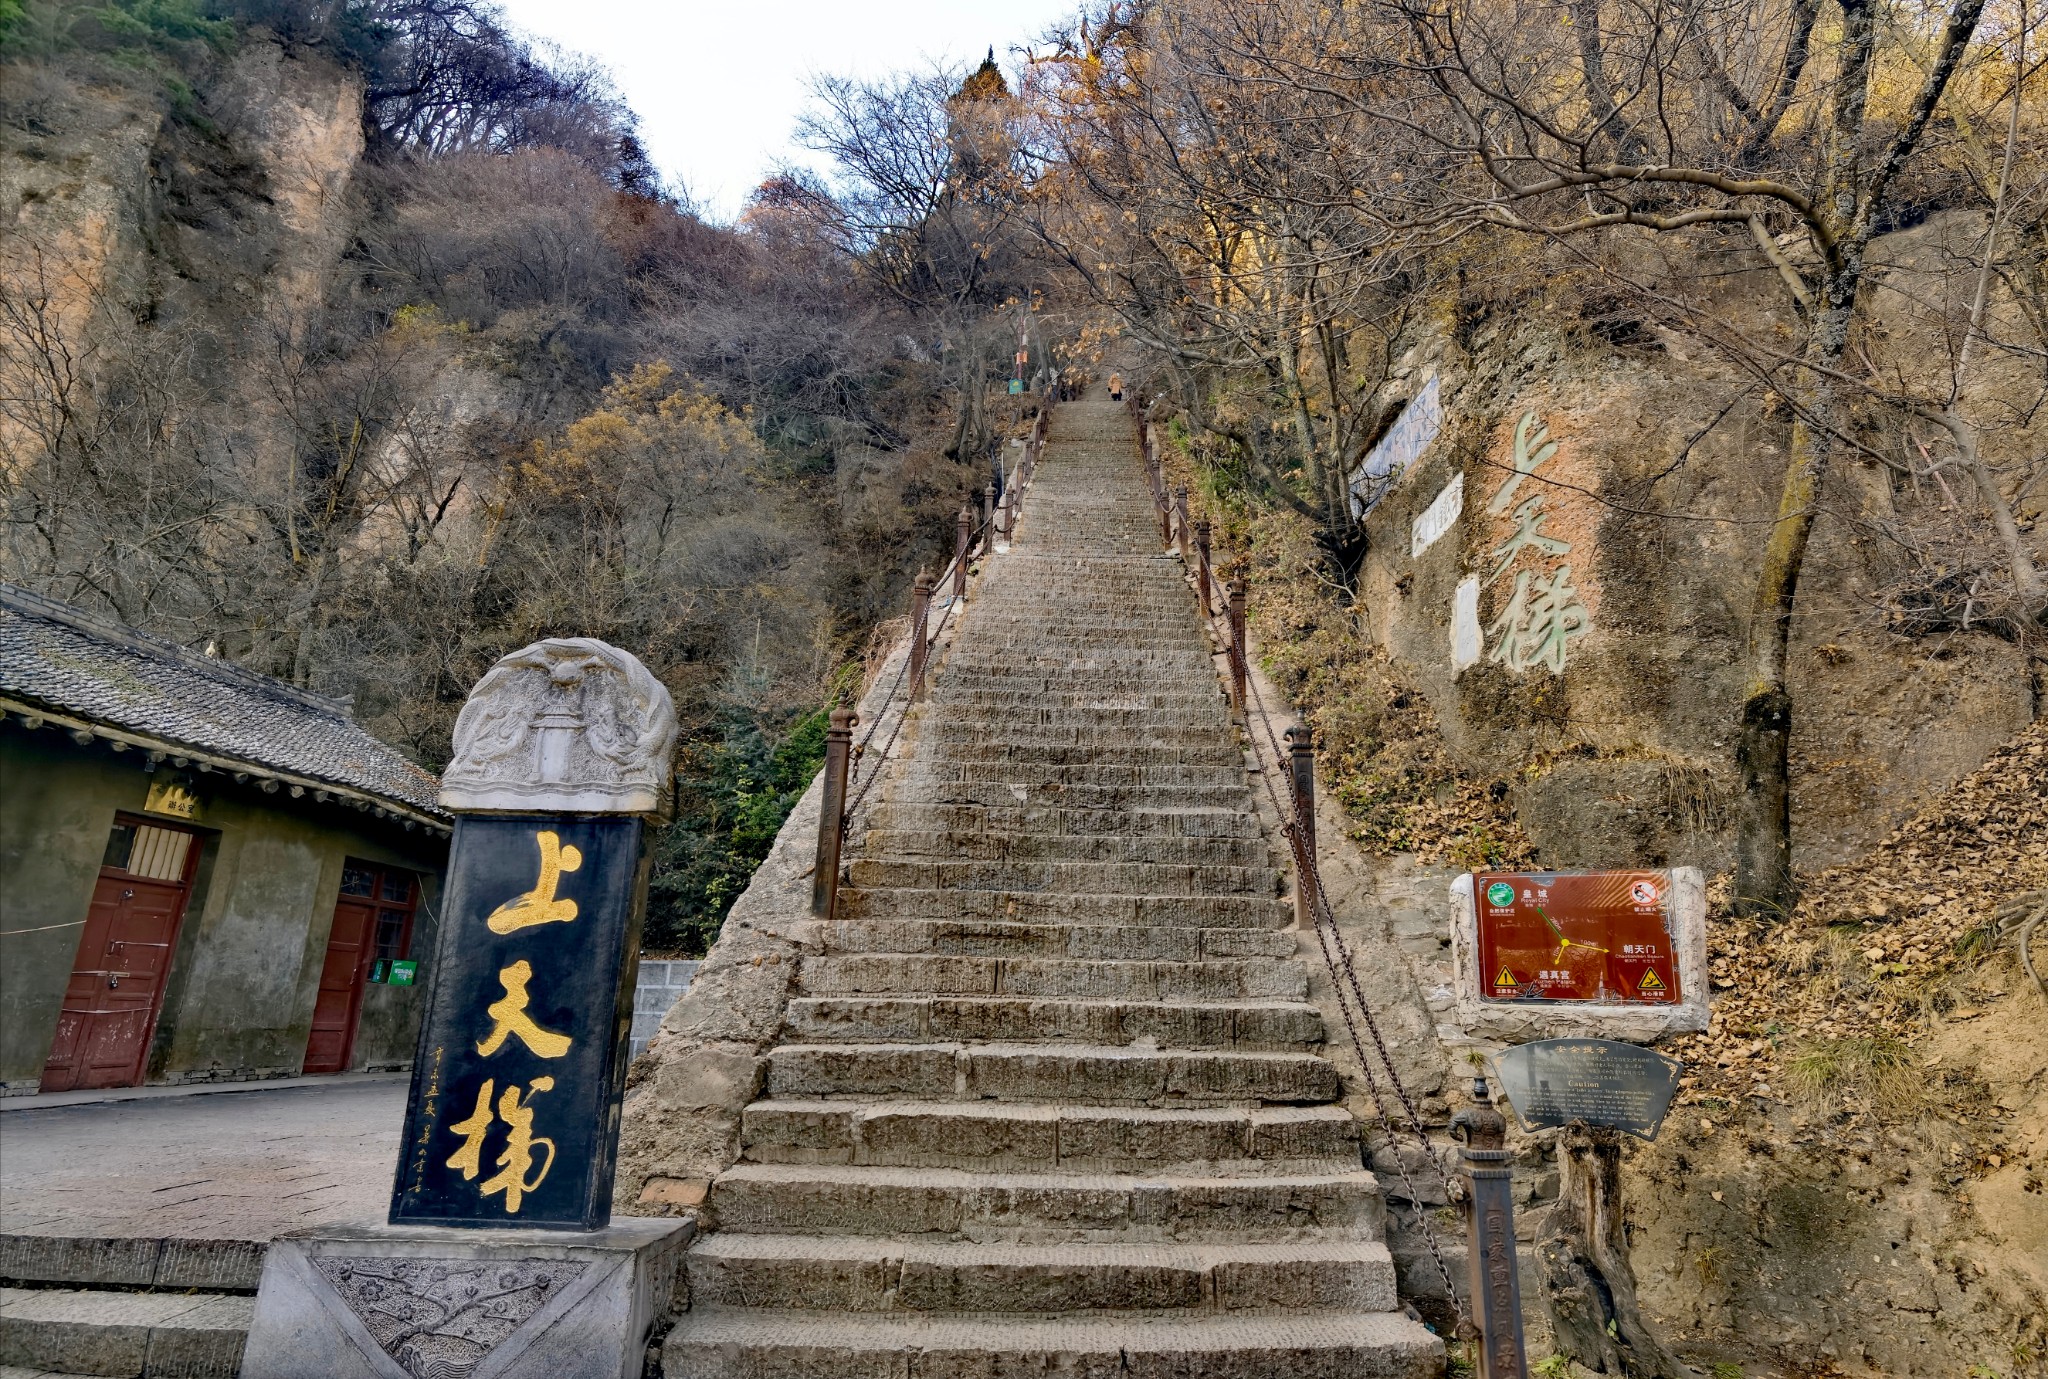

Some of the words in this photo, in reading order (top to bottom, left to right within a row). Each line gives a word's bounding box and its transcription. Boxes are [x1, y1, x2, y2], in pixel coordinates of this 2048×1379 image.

[1623, 944, 1656, 954] 朝天门
[446, 831, 583, 1213] 上天梯
[1555, 1045, 1608, 1054] 安全提示
[1568, 1080, 1600, 1088] Caution
